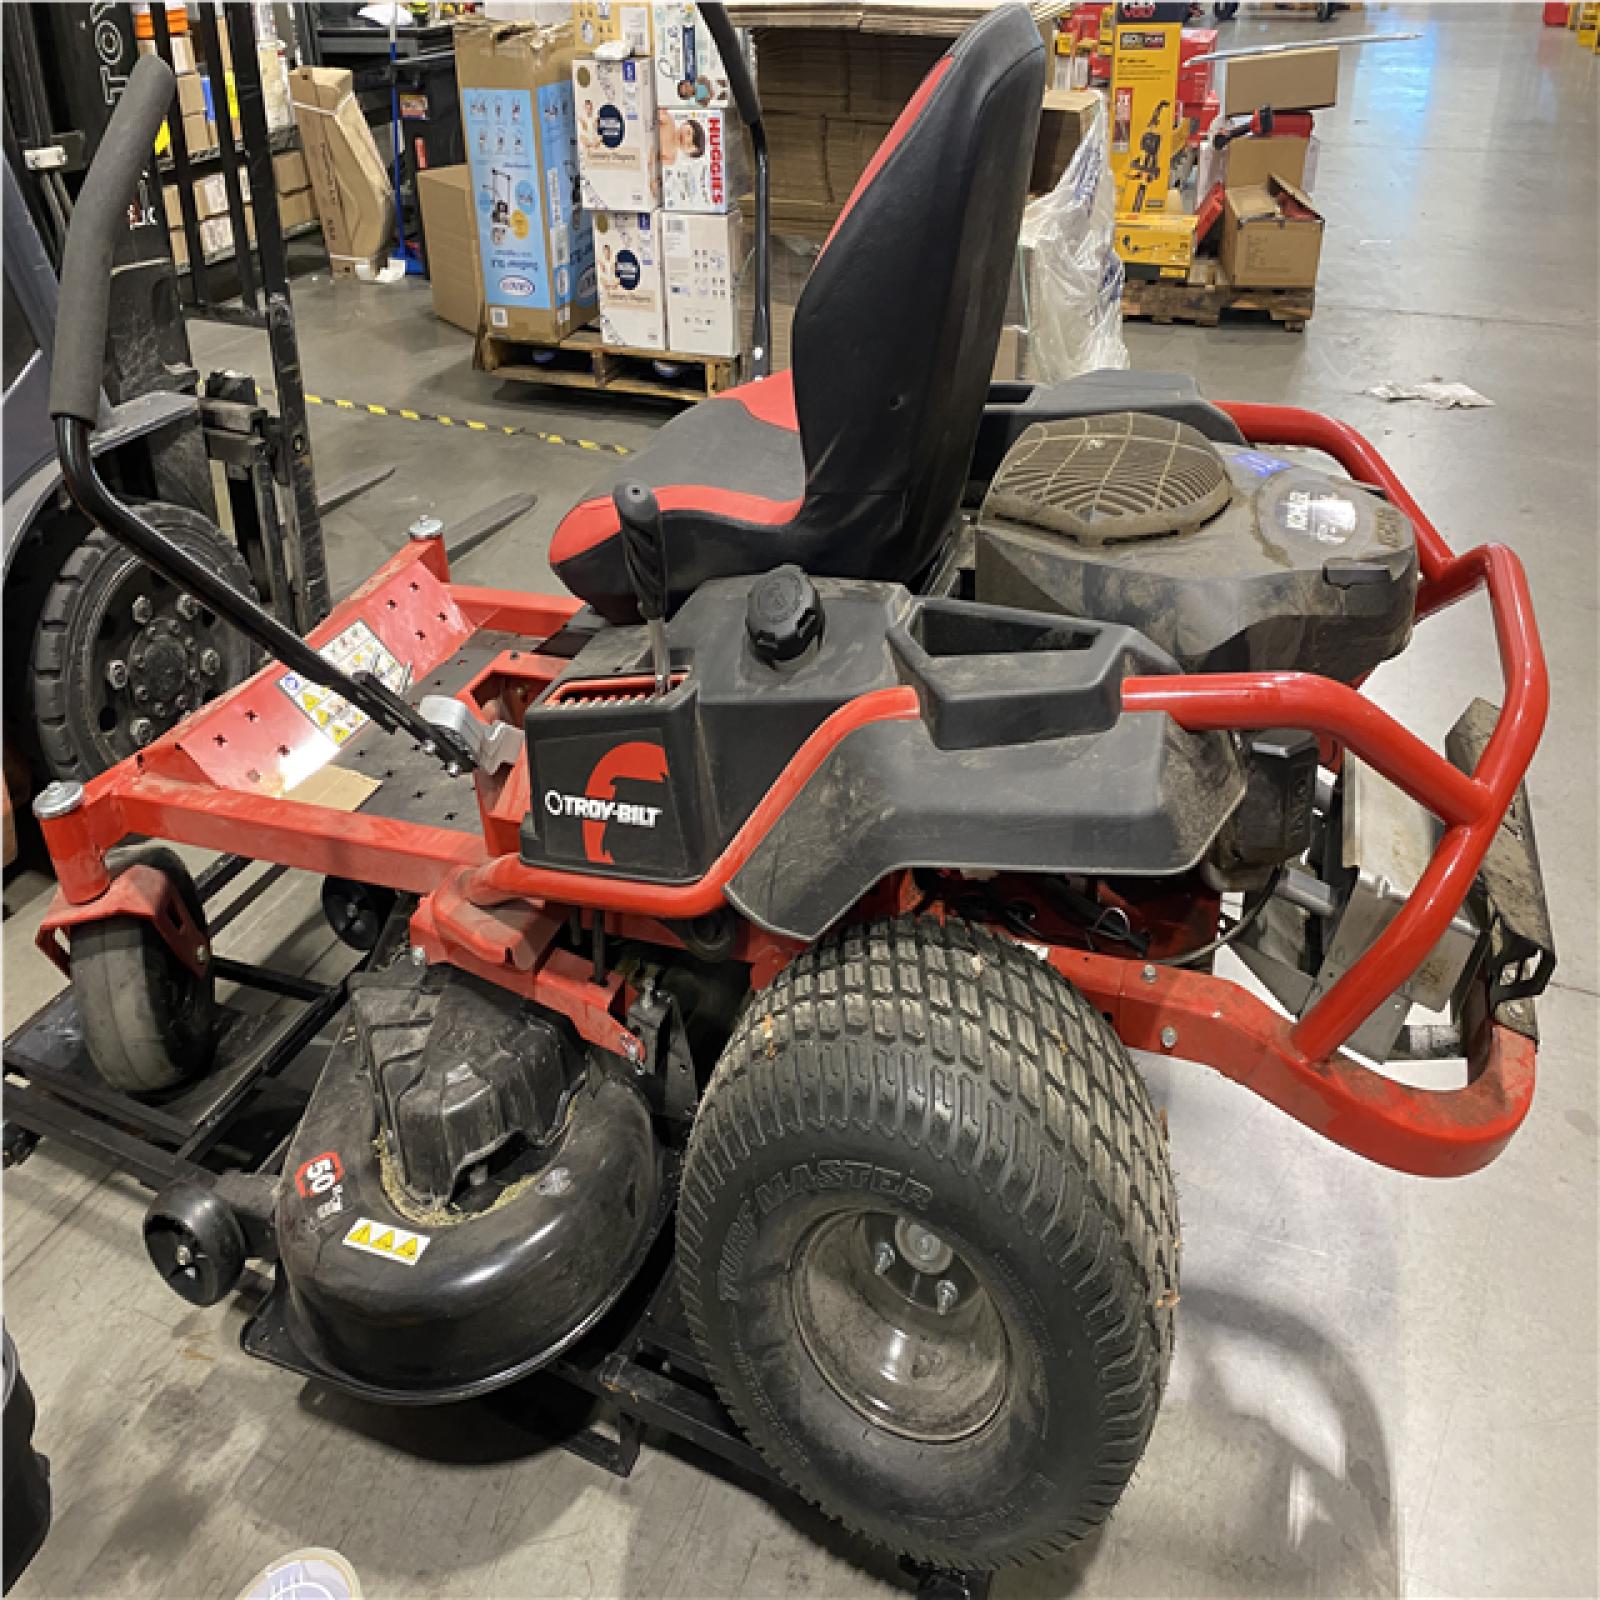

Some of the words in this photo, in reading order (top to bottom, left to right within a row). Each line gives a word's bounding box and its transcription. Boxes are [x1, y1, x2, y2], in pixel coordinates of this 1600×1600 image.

[708, 117, 723, 205] HUGGIES
[562, 795, 663, 829] TROY-BILT
[307, 1159, 335, 1193] 50
[754, 1159, 934, 1212] MASTER
